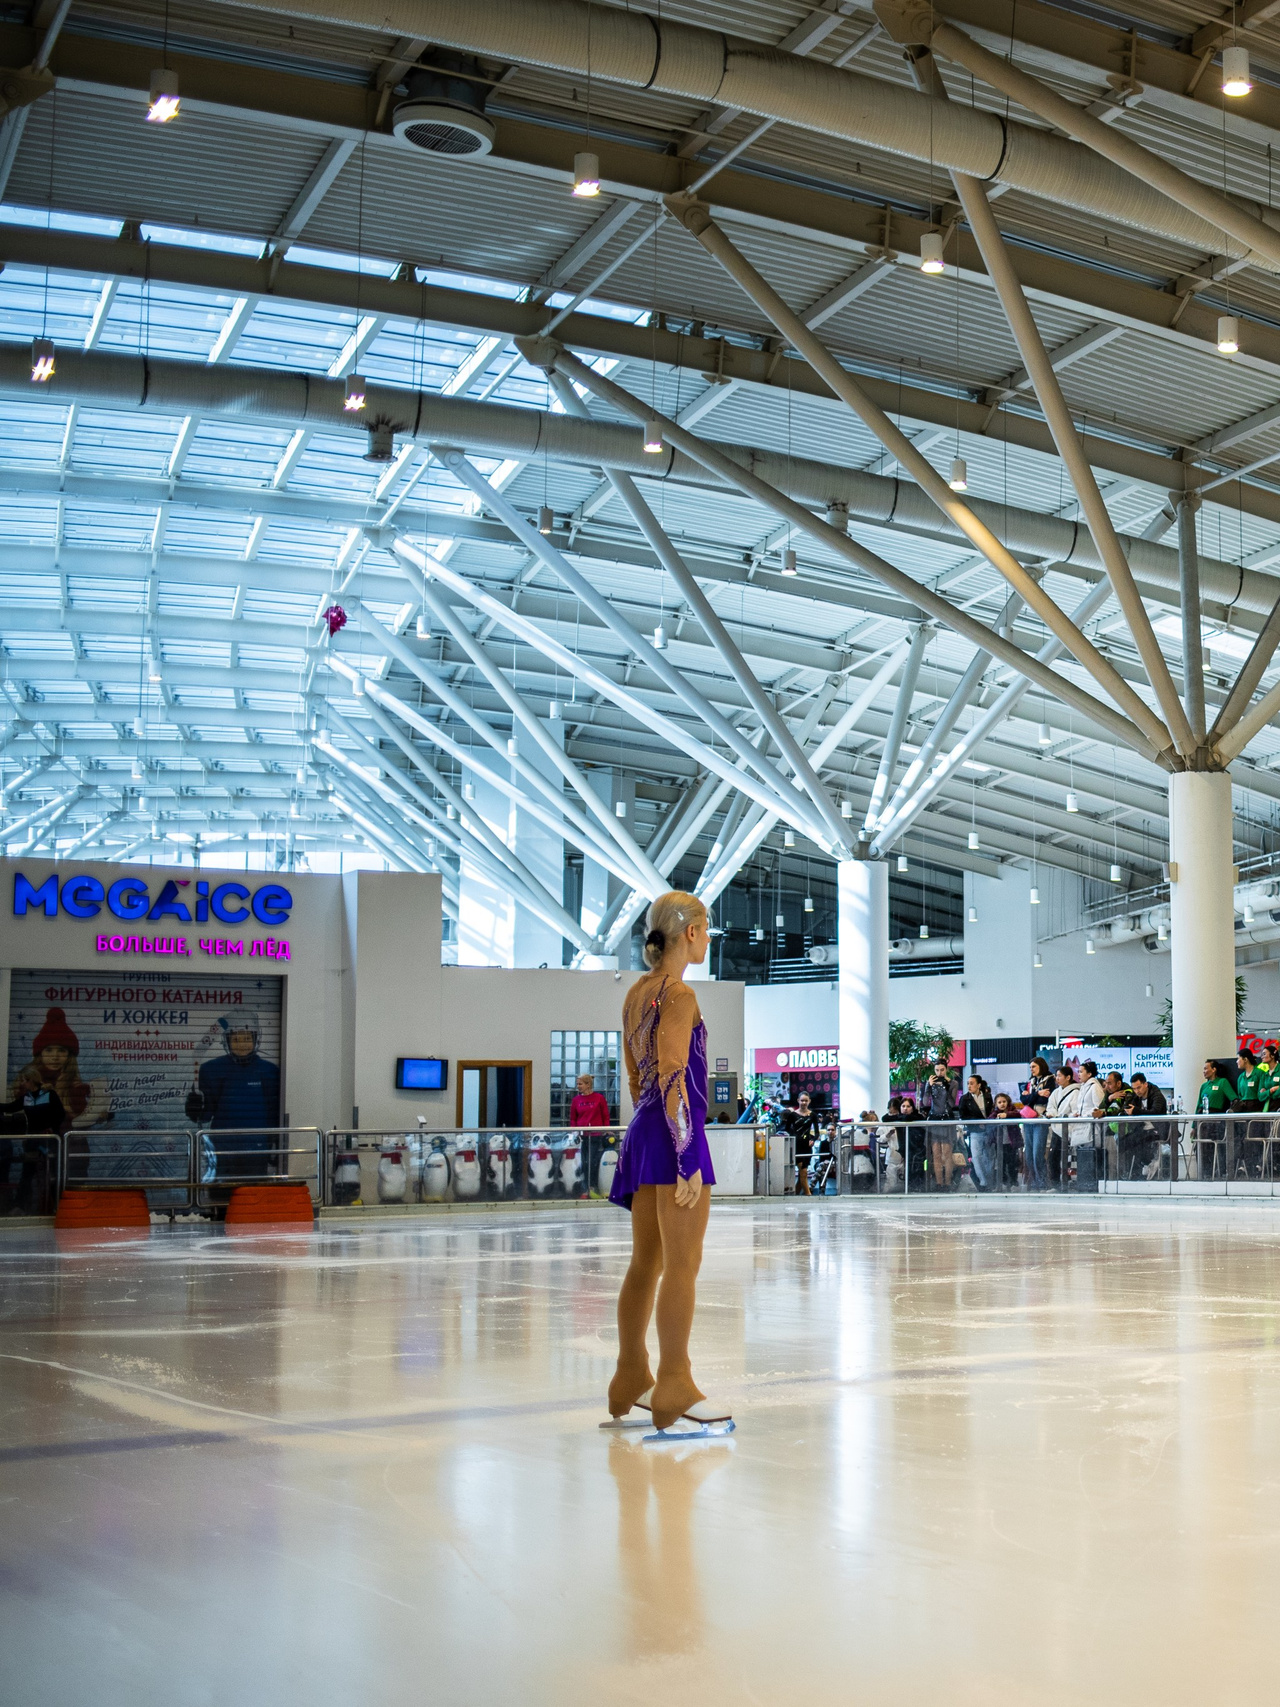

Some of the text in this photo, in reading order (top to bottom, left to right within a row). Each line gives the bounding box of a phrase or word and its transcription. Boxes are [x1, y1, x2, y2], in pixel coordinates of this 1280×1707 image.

[96, 934, 291, 960] БОЛЬШЕ, ЧЕМ ЛЁД
[45, 987, 243, 1005] ФИГУРНОГО КАТАНИЯ
[103, 1010, 189, 1025] И ХОККЕЯ
[95, 1040, 195, 1051] ИНДИВИДУАЛЬНЫЕ
[112, 1053, 178, 1063] ТРЕНИРОВКИ
[1136, 1053, 1171, 1061] СЫРНЫЕ
[105, 1073, 167, 1093] Мы рады
[108, 1082, 187, 1112] Вас видеть!
